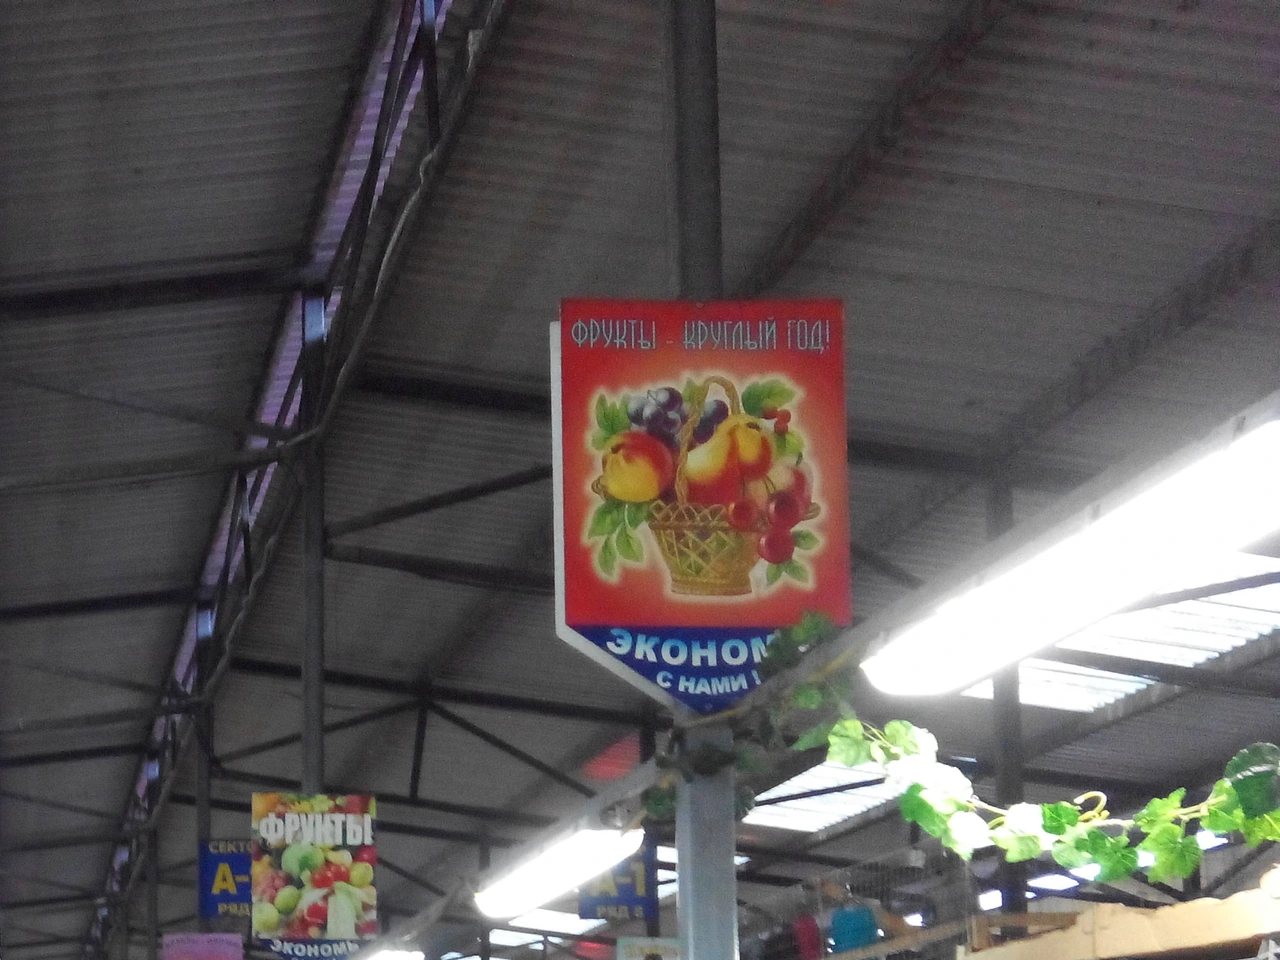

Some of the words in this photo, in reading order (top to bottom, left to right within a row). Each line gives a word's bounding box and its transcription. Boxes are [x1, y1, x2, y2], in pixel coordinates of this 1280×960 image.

[571, 318, 656, 349] ФРУКТЫ
[683, 316, 777, 351] КРУГЛЫЙ
[787, 319, 831, 354] ГОД!
[606, 628, 778, 667] ЭКОНОМ
[656, 671, 673, 688] С
[678, 674, 748, 696] НАМИ
[259, 813, 374, 846] ФРУКТЫ
